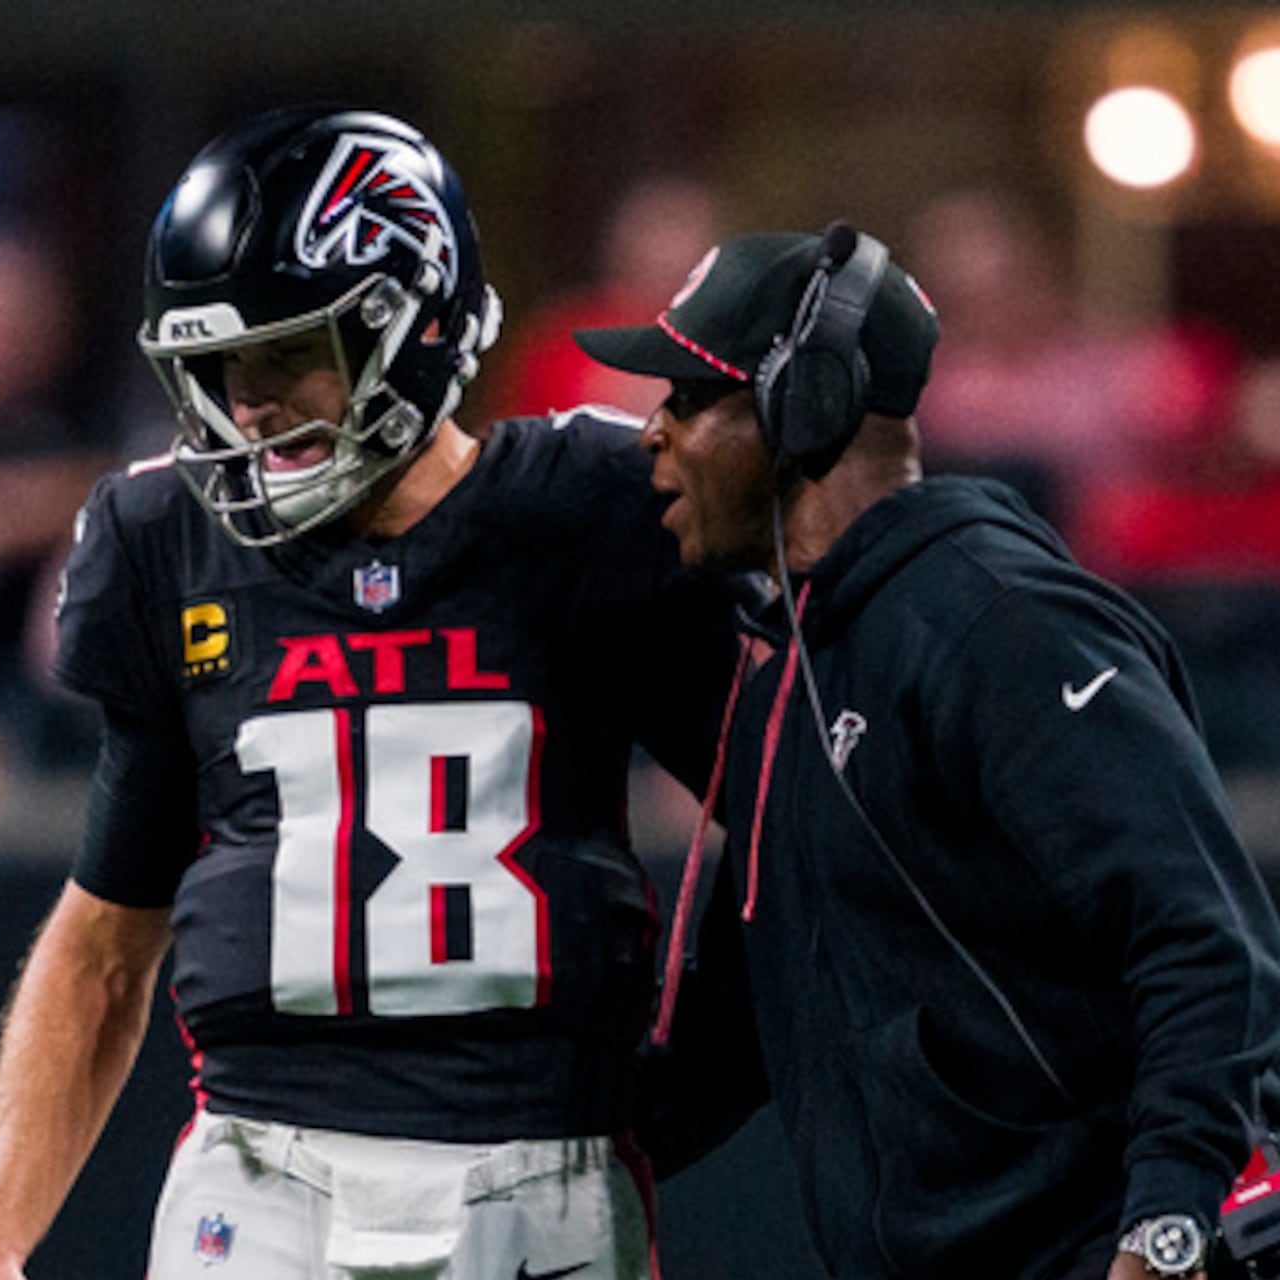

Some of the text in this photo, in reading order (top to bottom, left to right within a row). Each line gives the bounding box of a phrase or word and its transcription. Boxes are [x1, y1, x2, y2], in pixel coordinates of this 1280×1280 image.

[170, 319, 216, 341] ATL
[181, 603, 229, 663] C
[268, 627, 511, 702] ATL
[235, 701, 552, 1017] 18
